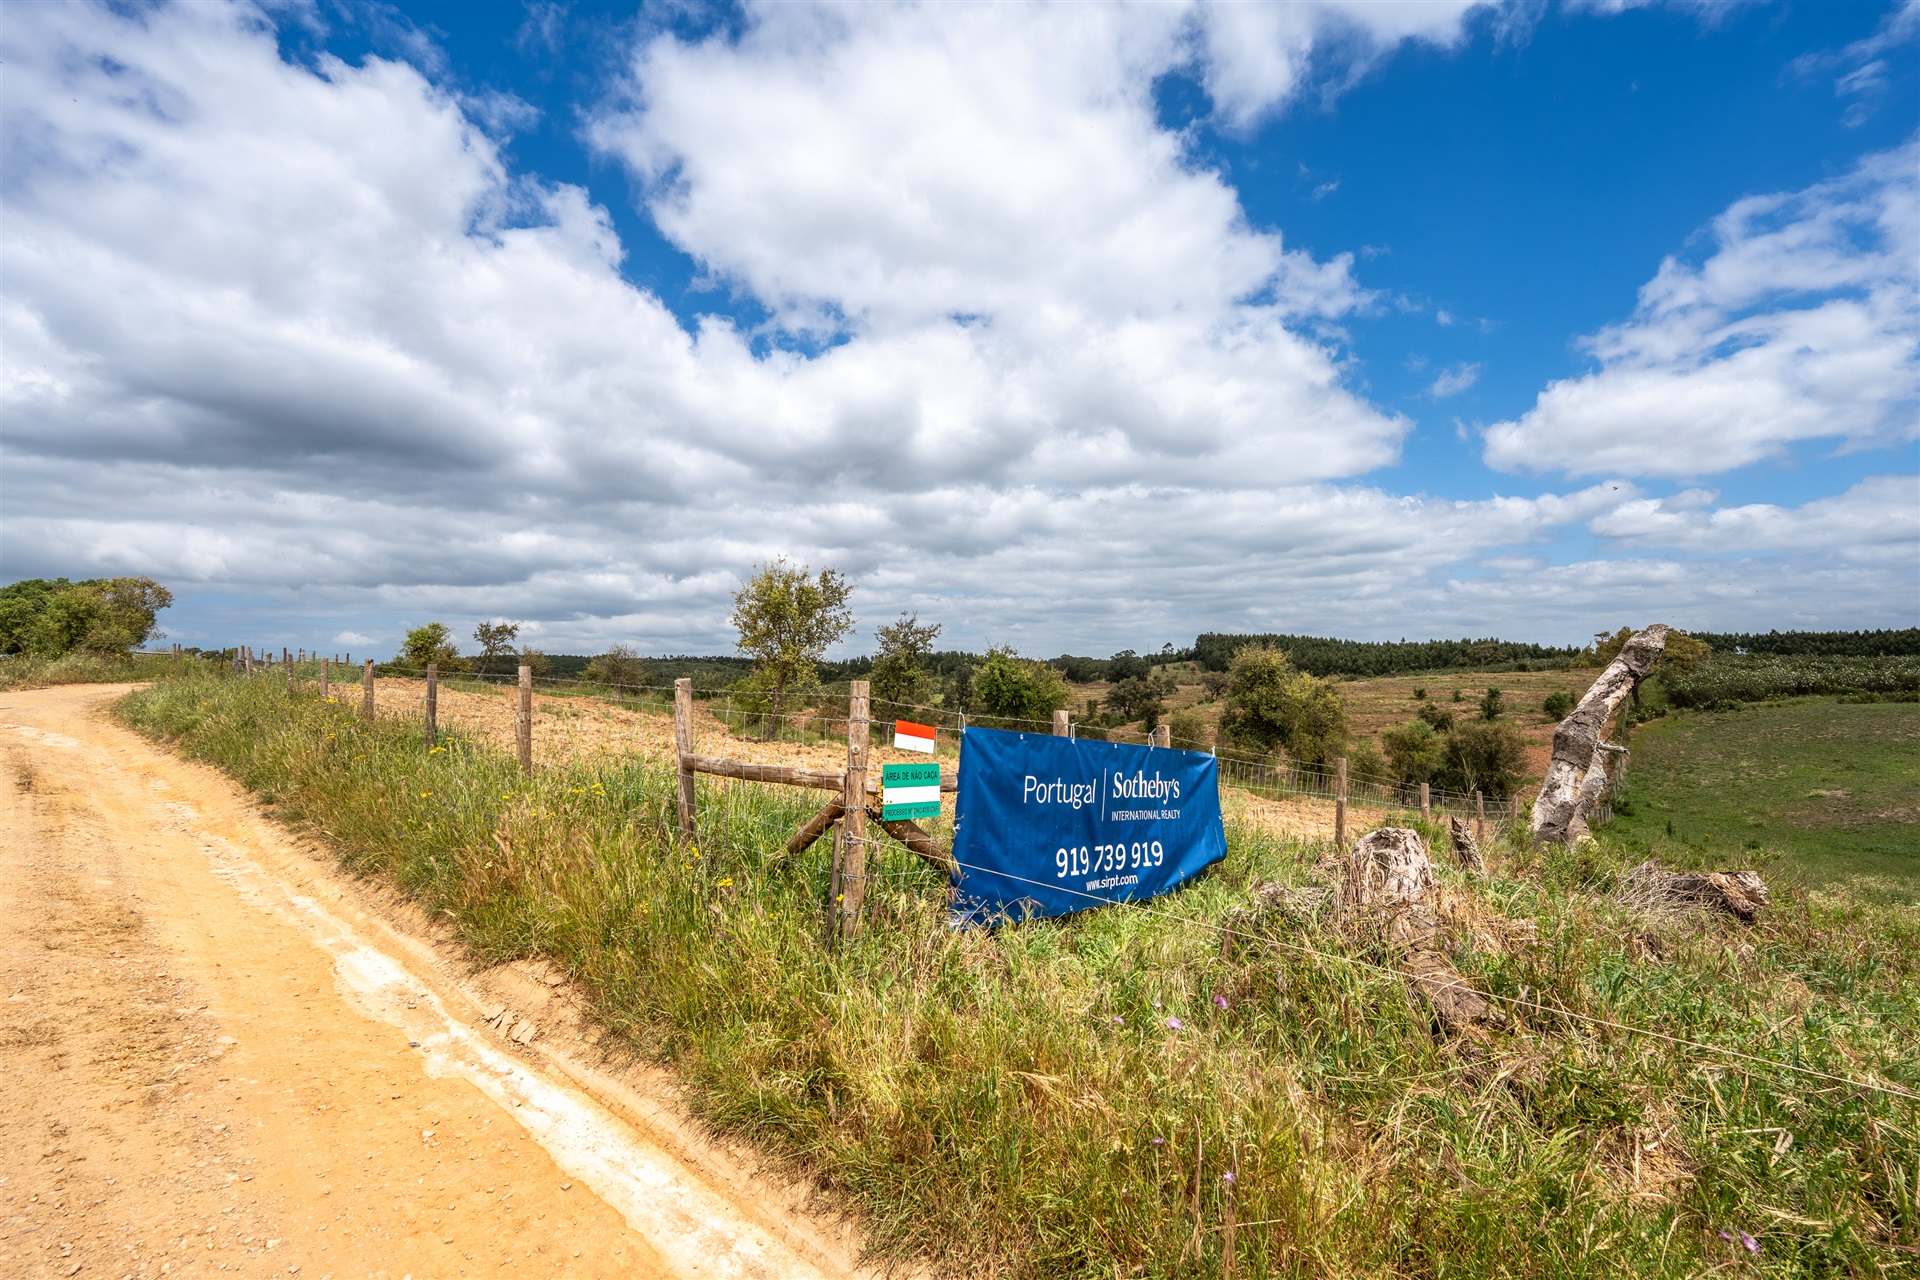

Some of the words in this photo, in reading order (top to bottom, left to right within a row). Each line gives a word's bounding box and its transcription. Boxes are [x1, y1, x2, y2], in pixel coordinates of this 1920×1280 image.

[886, 771, 900, 781] ÁREA
[902, 772, 909, 780] DE
[911, 770, 922, 780] NÃO
[924, 770, 938, 781] CAÇA
[1023, 775, 1097, 810] Portugal
[1112, 769, 1181, 805] Sotheby's
[885, 807, 907, 817] PROCESSO
[1111, 810, 1161, 822] INTERNATIONAL
[1161, 809, 1181, 820] REALTY
[1056, 846, 1089, 878] 919
[1094, 843, 1126, 873] 739
[1131, 841, 1164, 869] 919
[1086, 874, 1139, 892] www.sirpt.com
